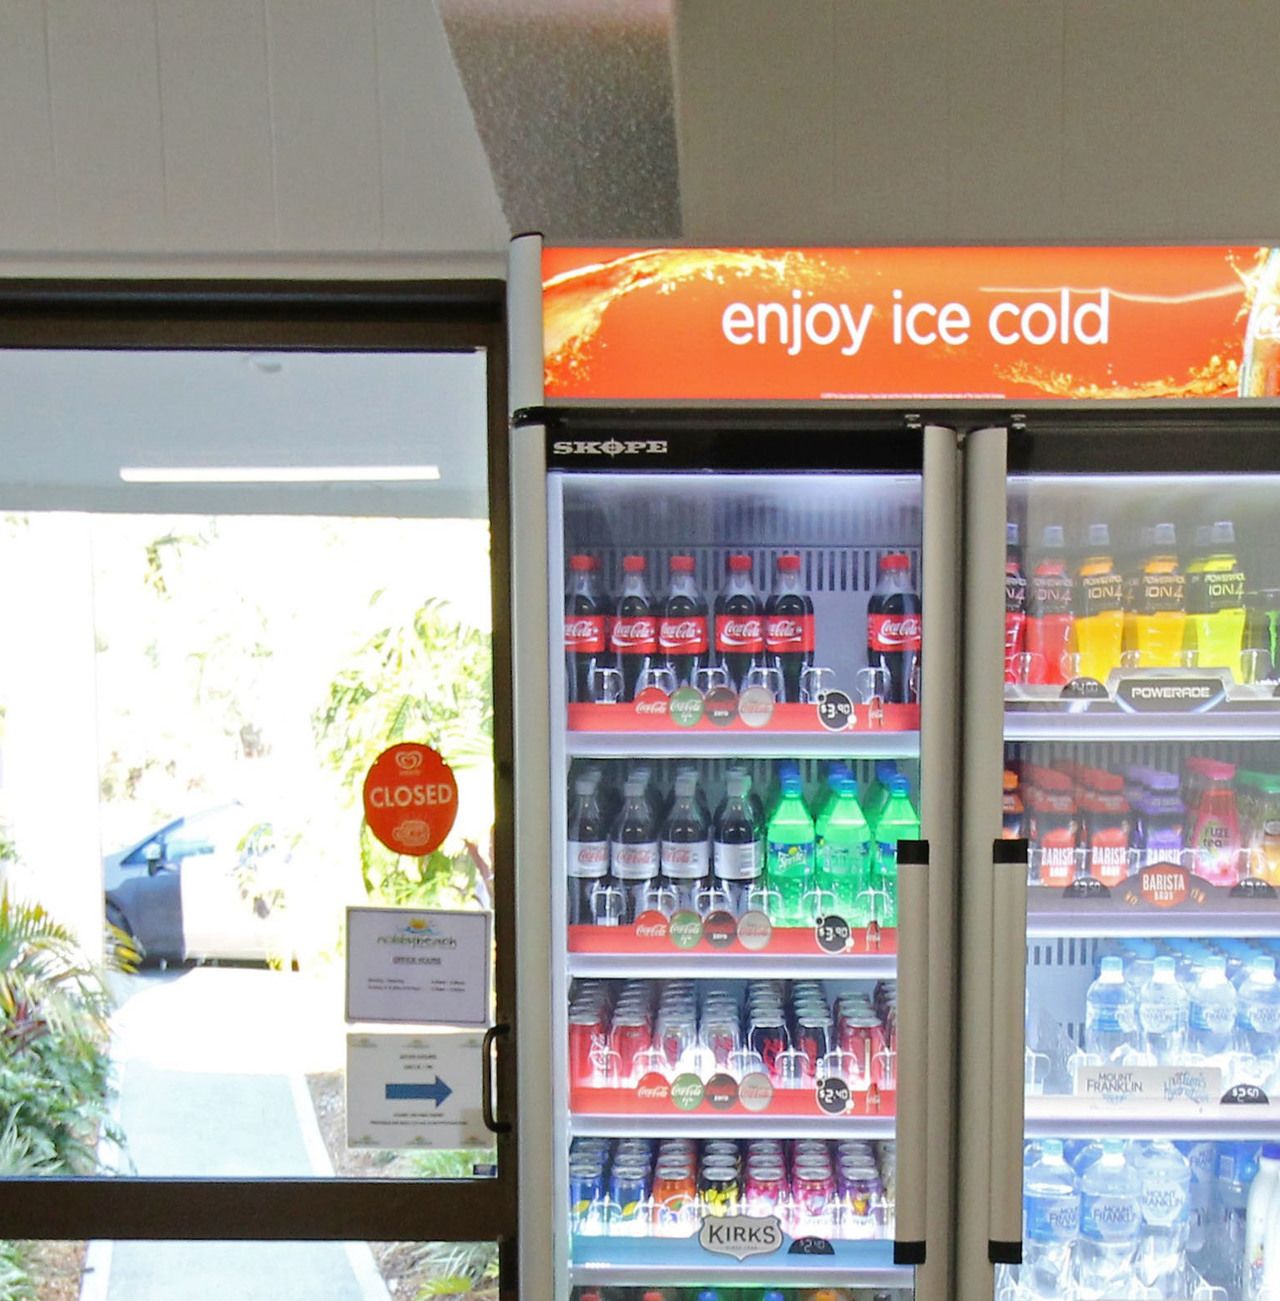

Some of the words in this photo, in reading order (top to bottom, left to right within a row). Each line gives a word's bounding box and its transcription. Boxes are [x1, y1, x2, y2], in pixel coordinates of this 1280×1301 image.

[721, 289, 874, 356] enjoy
[893, 289, 971, 345] ice
[988, 287, 1110, 345] cold
[553, 438, 668, 457] SKOPE
[612, 620, 656, 640] Coca-Cola
[1131, 686, 1210, 699] POWERADE
[370, 784, 453, 808] CLOSED
[777, 852, 808, 869] Sprite
[1142, 873, 1185, 892] BARISTA
[1086, 1079, 1142, 1093] FRANKLIN
[1098, 1072, 1132, 1083] MOUNT
[708, 1223, 776, 1245] KIRKS
